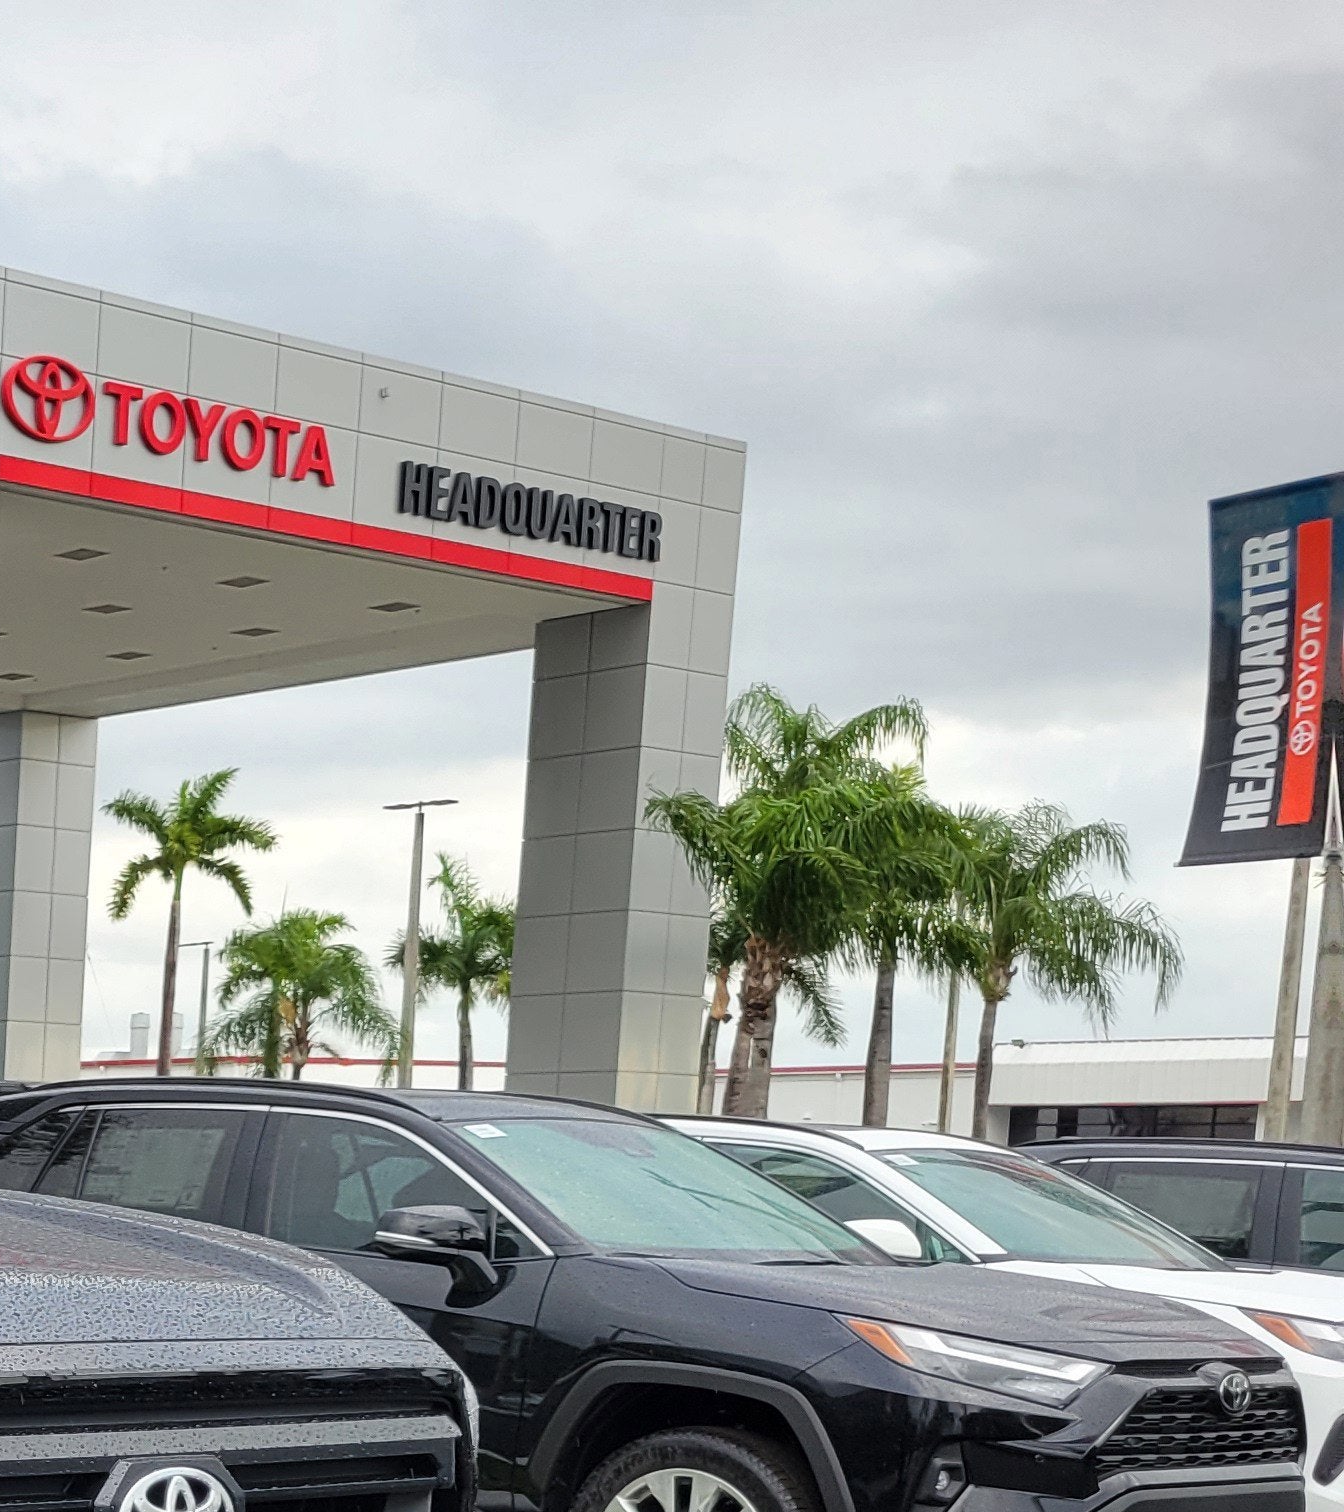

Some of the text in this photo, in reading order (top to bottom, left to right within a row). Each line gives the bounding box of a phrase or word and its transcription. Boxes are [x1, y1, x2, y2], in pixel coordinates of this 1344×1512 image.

[104, 381, 663, 561] TOYOTA HEADQUARTER
[1220, 529, 1290, 833] HEADQUARTER
[1295, 602, 1323, 719] TOYOTA
